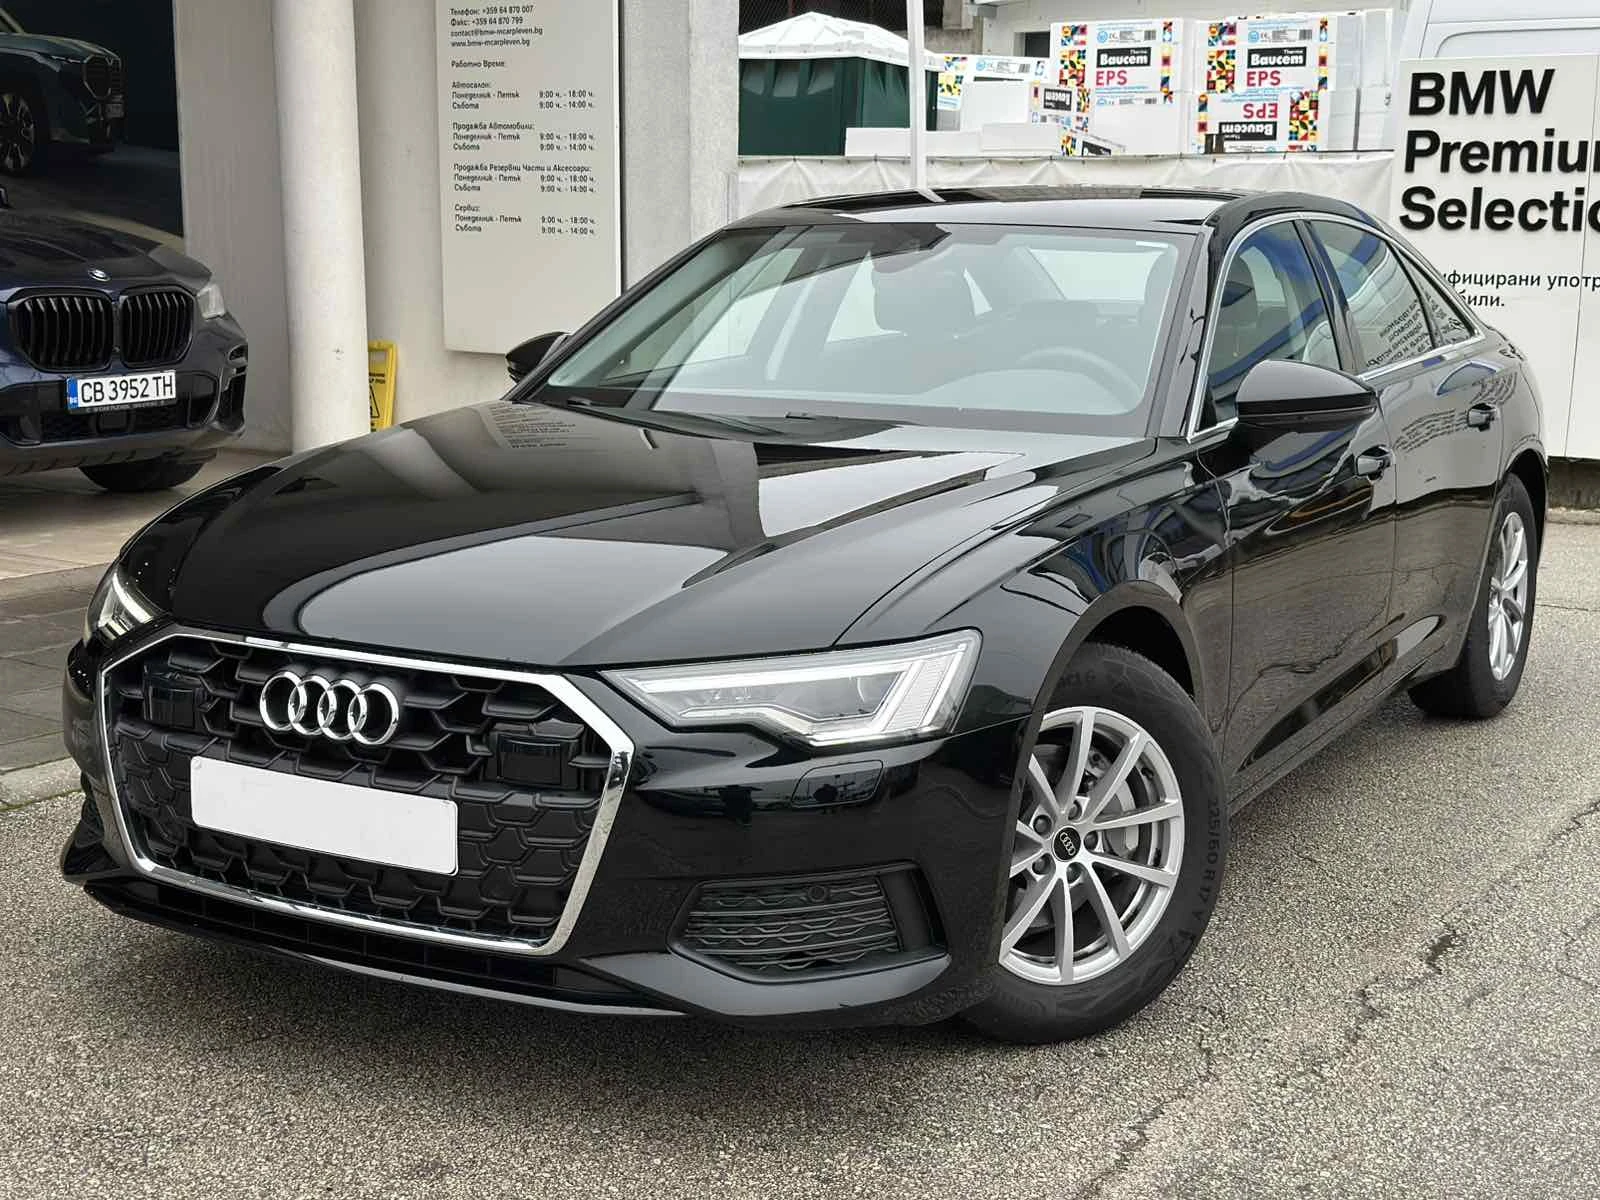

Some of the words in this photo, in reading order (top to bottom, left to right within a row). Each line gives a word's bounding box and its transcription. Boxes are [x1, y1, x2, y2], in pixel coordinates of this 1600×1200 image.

[1100, 52, 1149, 66] Baucem
[1251, 53, 1304, 66] Baucem
[1096, 70, 1128, 86] EPS
[1246, 70, 1281, 87] EPS
[452, 91, 491, 101] Понеделник
[1408, 69, 1556, 116] BMW
[1243, 103, 1278, 119] EPS
[453, 133, 492, 142] Понеделник
[1221, 124, 1274, 136] Baucem
[1404, 128, 1600, 174] Premiu
[454, 174, 493, 183] Понеделник
[455, 215, 494, 224] Понеделник
[1443, 270, 1541, 289] фицирани
[81, 381, 105, 403] CB
[108, 378, 149, 401] 3952
[152, 375, 174, 397] TH
